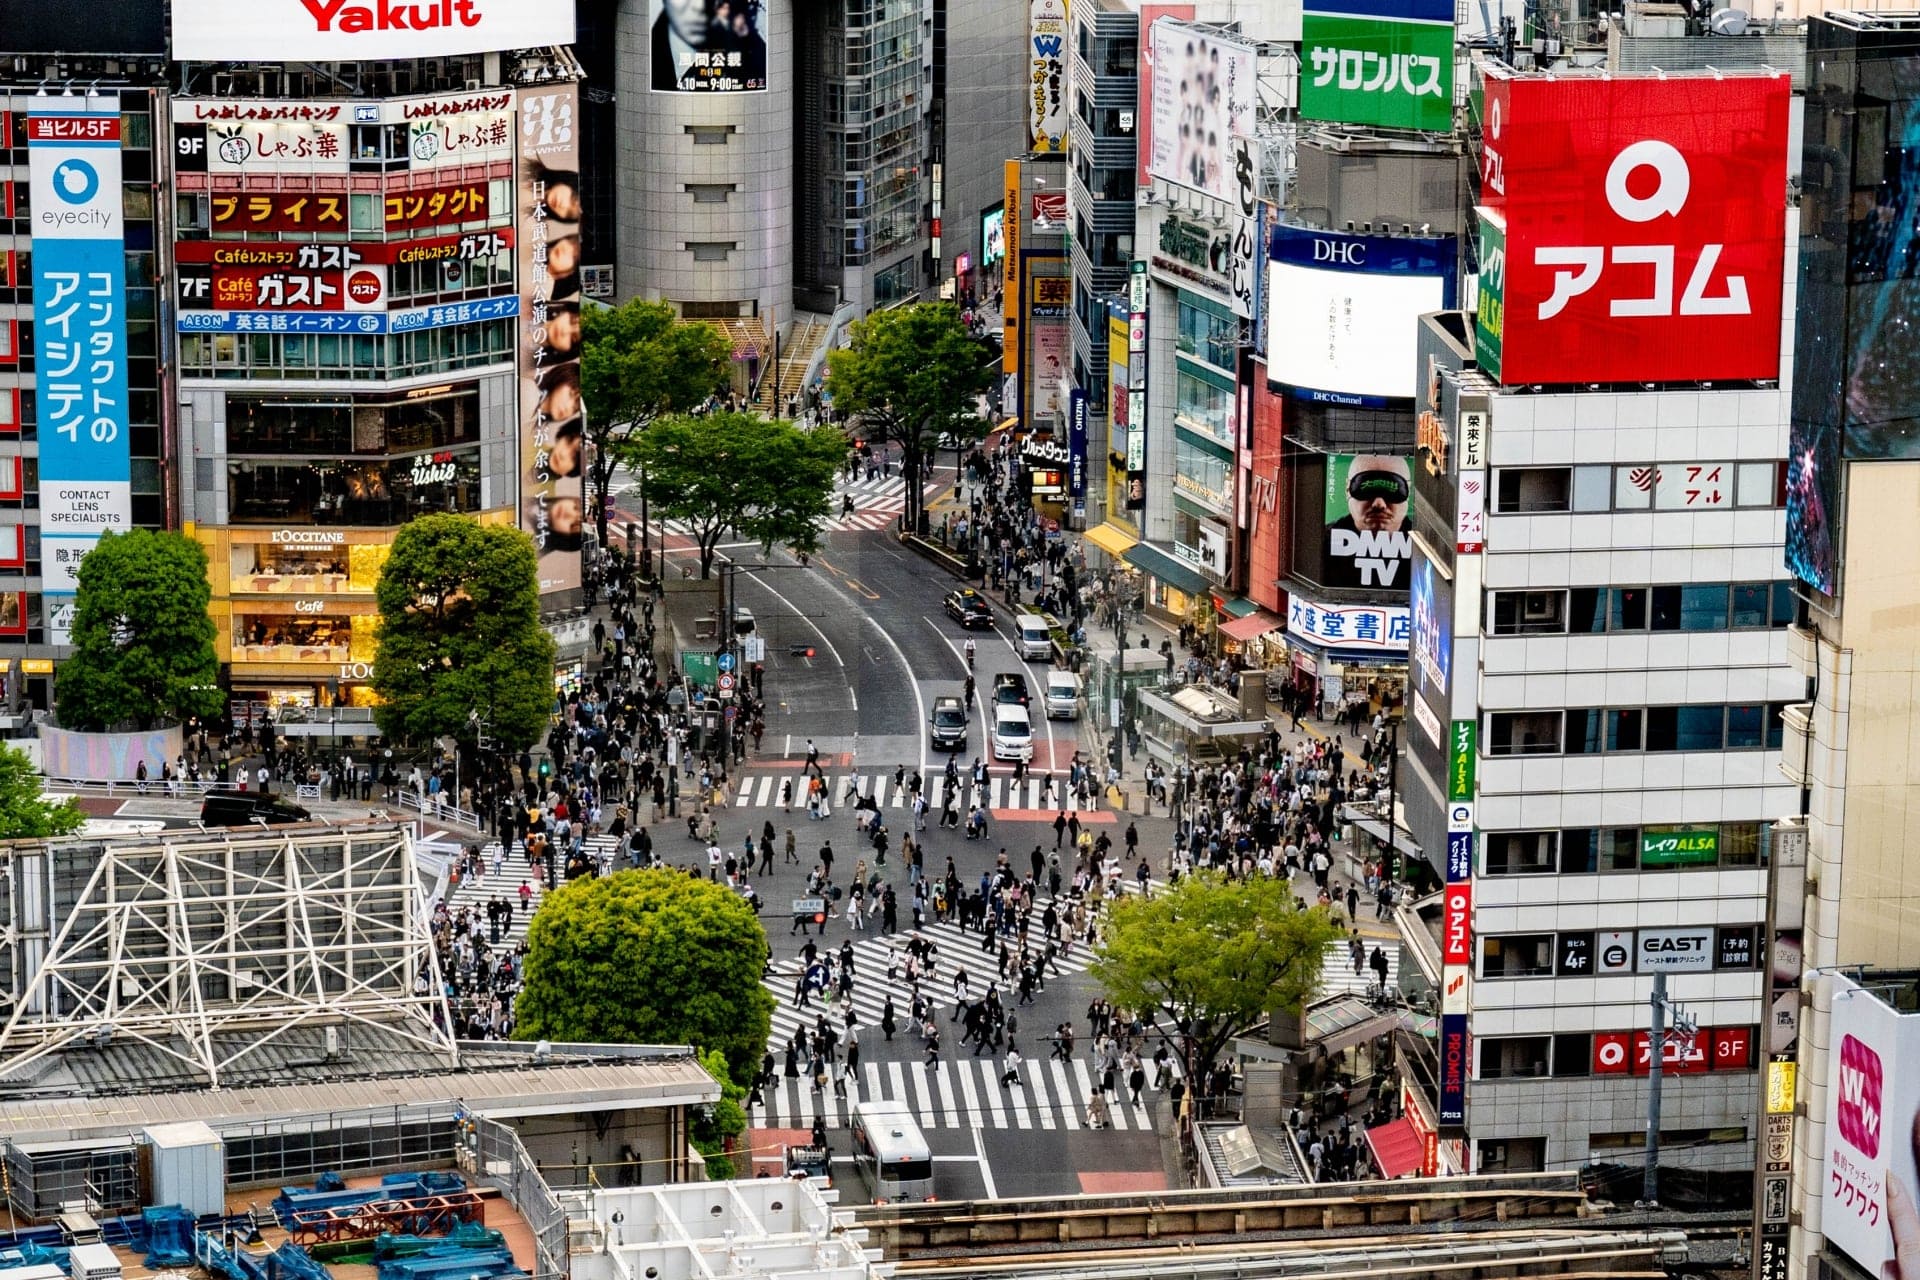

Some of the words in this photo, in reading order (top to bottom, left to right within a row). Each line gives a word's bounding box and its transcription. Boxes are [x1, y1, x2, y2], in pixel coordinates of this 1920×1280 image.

[303, 0, 481, 33] Yakult
[1311, 46, 1442, 98] サロンパス
[710, 78, 731, 90] 9:00
[195, 104, 342, 121] しゃぶしゃぶバイキング
[404, 94, 511, 119] しゃぶしゃぶバイキング
[38, 120, 111, 137] 当ビル5F
[444, 118, 508, 151] しゃぶ葉
[178, 138, 203, 154] 9F
[257, 132, 339, 160] しゃぶ葉
[1484, 145, 1504, 196] アコム
[213, 196, 343, 222] プライス
[385, 188, 484, 222] コンタクト
[42, 209, 112, 229] eyecity
[299, 245, 361, 269] ガスト
[460, 233, 506, 261] ガスト
[1007, 228, 1017, 282] Matsumoto
[1313, 239, 1366, 265] DHC
[1479, 236, 1504, 290] レイク
[180, 278, 211, 297] 7F
[217, 277, 253, 292] Café
[257, 273, 336, 306] ガスト
[352, 285, 378, 295] ガスト
[1039, 279, 1072, 302] 薬
[1534, 244, 1752, 320] アコム
[219, 293, 252, 302] レストラン
[183, 314, 223, 328] AEON
[236, 315, 351, 331] 英会話イーオン
[360, 317, 378, 329] 6F
[395, 312, 424, 328] AEON
[432, 300, 517, 325] 英会話イーオン
[1479, 287, 1503, 342] ALSA
[44, 272, 85, 443] アイシティ
[88, 272, 118, 443] コンタクトの
[532, 181, 550, 550] 日本武道館公演のチケットが余ってます
[1313, 392, 1331, 401] DHC
[1331, 393, 1362, 405] Channel
[410, 463, 456, 486] Ushi8
[1686, 466, 1723, 482] アイ
[59, 490, 111, 500] CONTACT
[1686, 490, 1722, 505] フル
[71, 502, 99, 511] LENS
[1461, 512, 1481, 521] アイ
[51, 513, 121, 523] SPECIALISTS
[1461, 524, 1481, 533] フル
[271, 530, 345, 544] L'OCCITANE
[1464, 543, 1476, 552] 8F
[1354, 558, 1400, 587] TV
[295, 600, 324, 613] Café
[1292, 603, 1410, 641] 大盛堂書店
[1456, 721, 1470, 794] レイクALSA
[1644, 837, 1715, 852] レイクALSA
[1451, 841, 1459, 873] クリニック
[1449, 912, 1464, 953] アコム
[1643, 936, 1707, 952] EAST
[1565, 951, 1587, 968] 4F
[1644, 955, 1706, 965] イースト駅前クリニック
[1718, 1040, 1744, 1057] 3F
[1446, 1033, 1461, 1093] PROMISE
[1768, 1115, 1791, 1124] DARTS
[1776, 1125, 1791, 1133] BAR
[1769, 1163, 1786, 1171] 6F
[1833, 1149, 1880, 1194] 劇的マッチング
[1832, 1169, 1880, 1227] ワクワク
[1768, 1225, 1780, 1233] 5F
